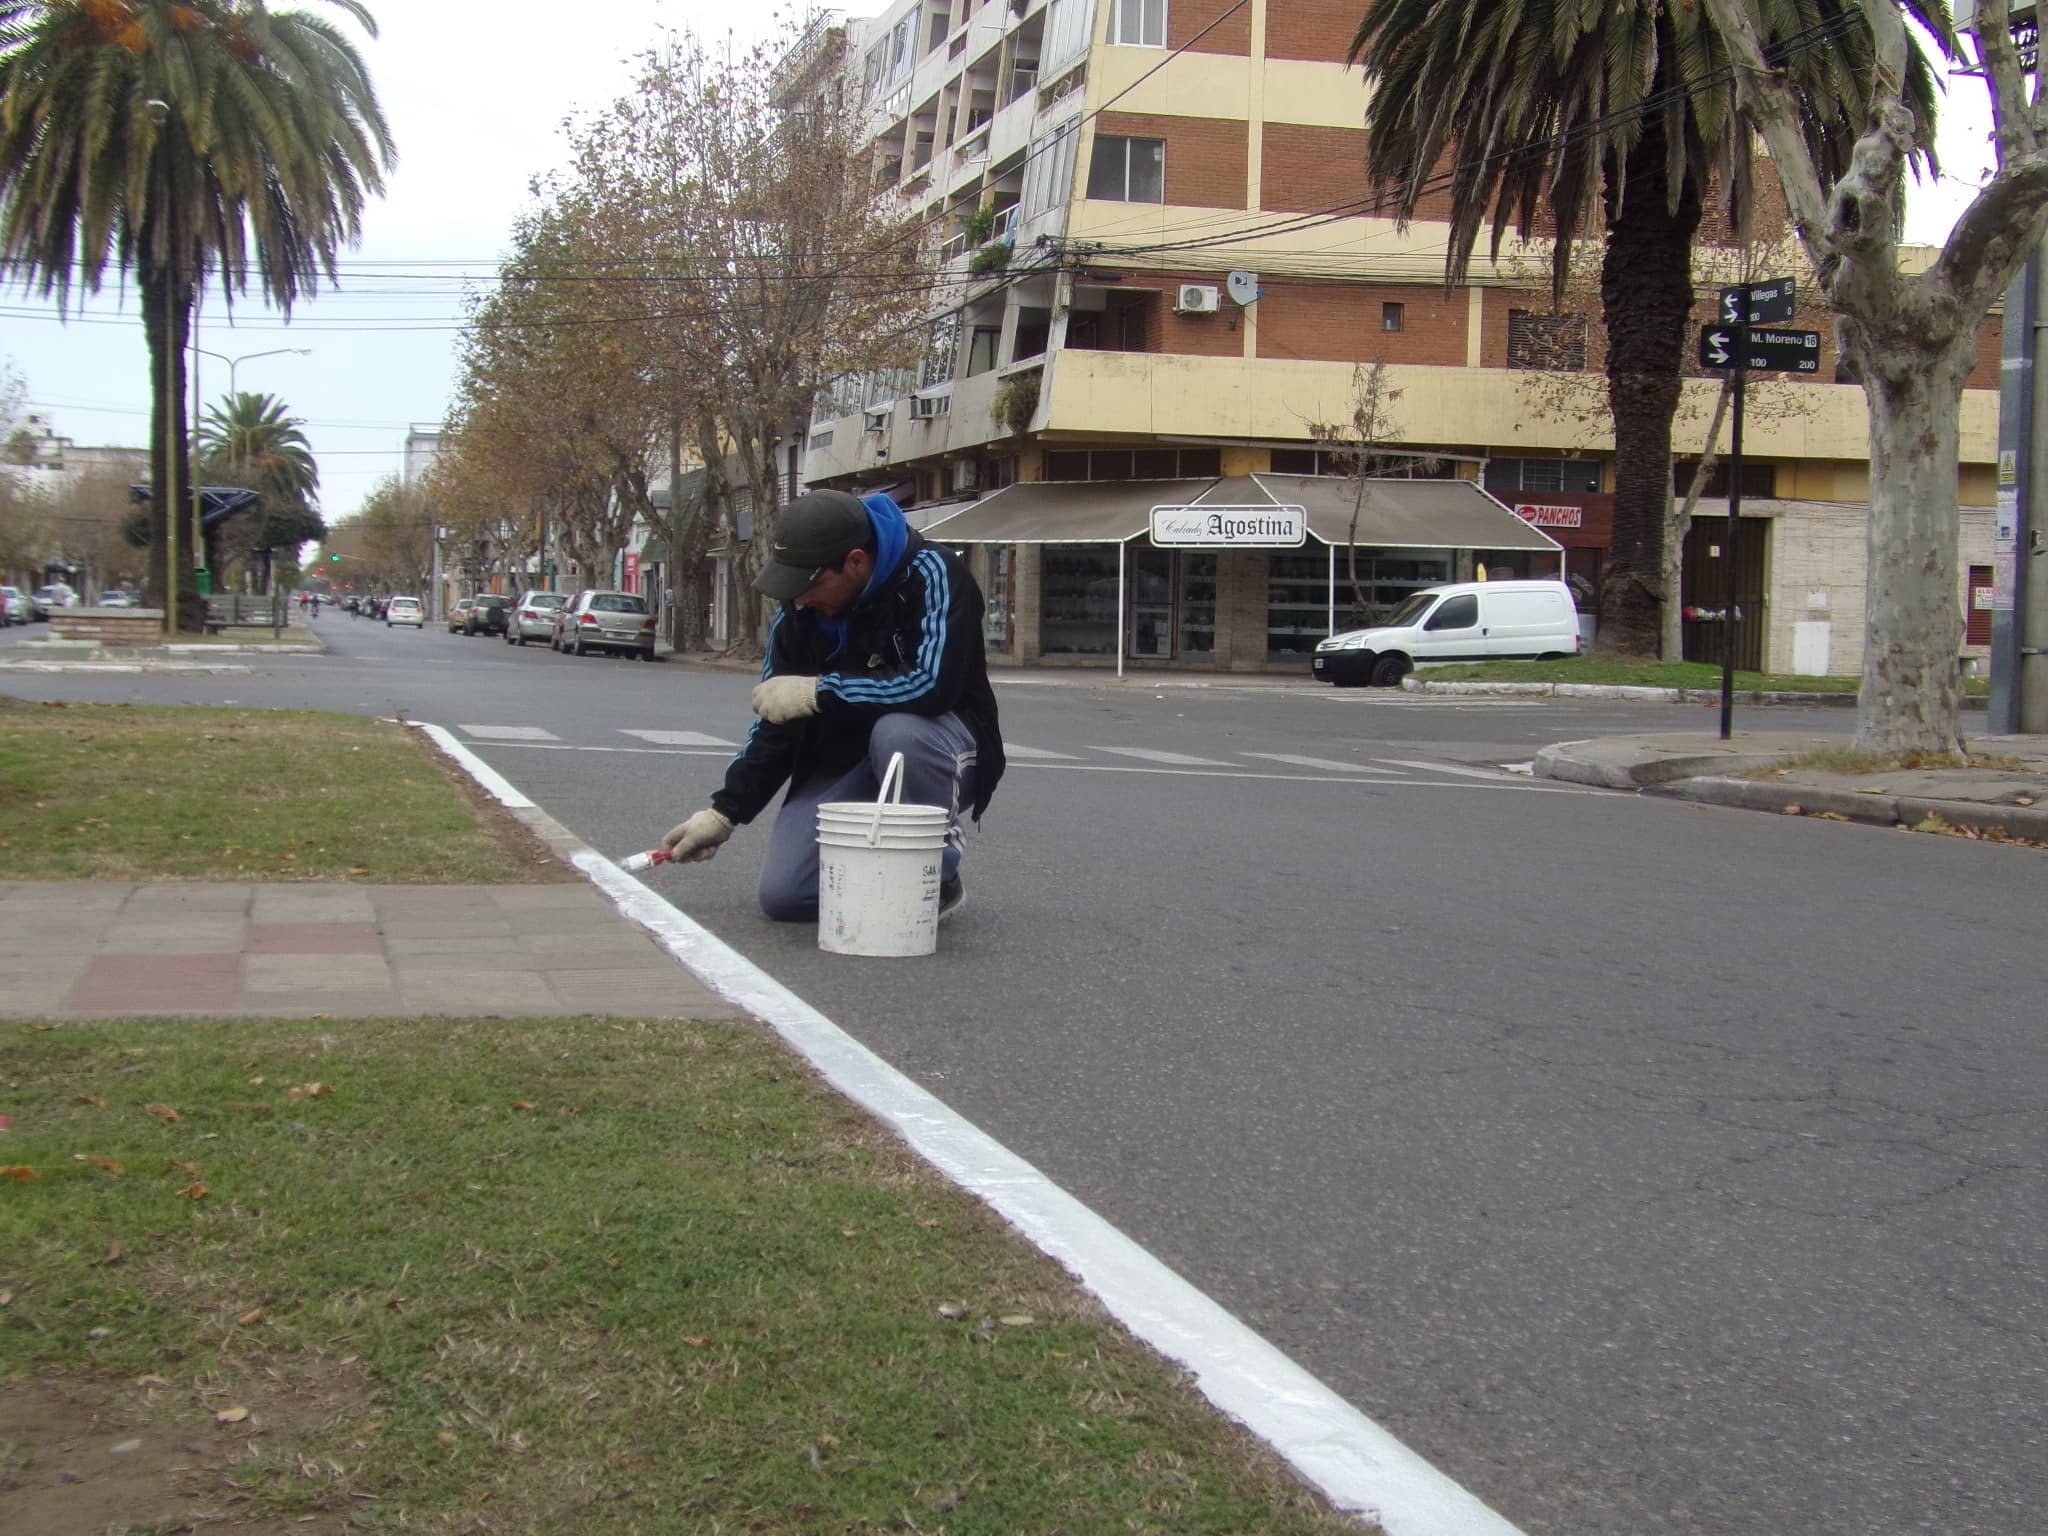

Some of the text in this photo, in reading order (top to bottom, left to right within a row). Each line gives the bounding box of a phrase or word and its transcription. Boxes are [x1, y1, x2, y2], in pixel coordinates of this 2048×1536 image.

[1750, 289, 1778, 302] Villegas
[1751, 333, 1817, 348] M. Moreno 16
[1751, 358, 1816, 369] 100 200
[1537, 507, 1580, 525] PANCHOS
[1206, 514, 1293, 539] Agostina
